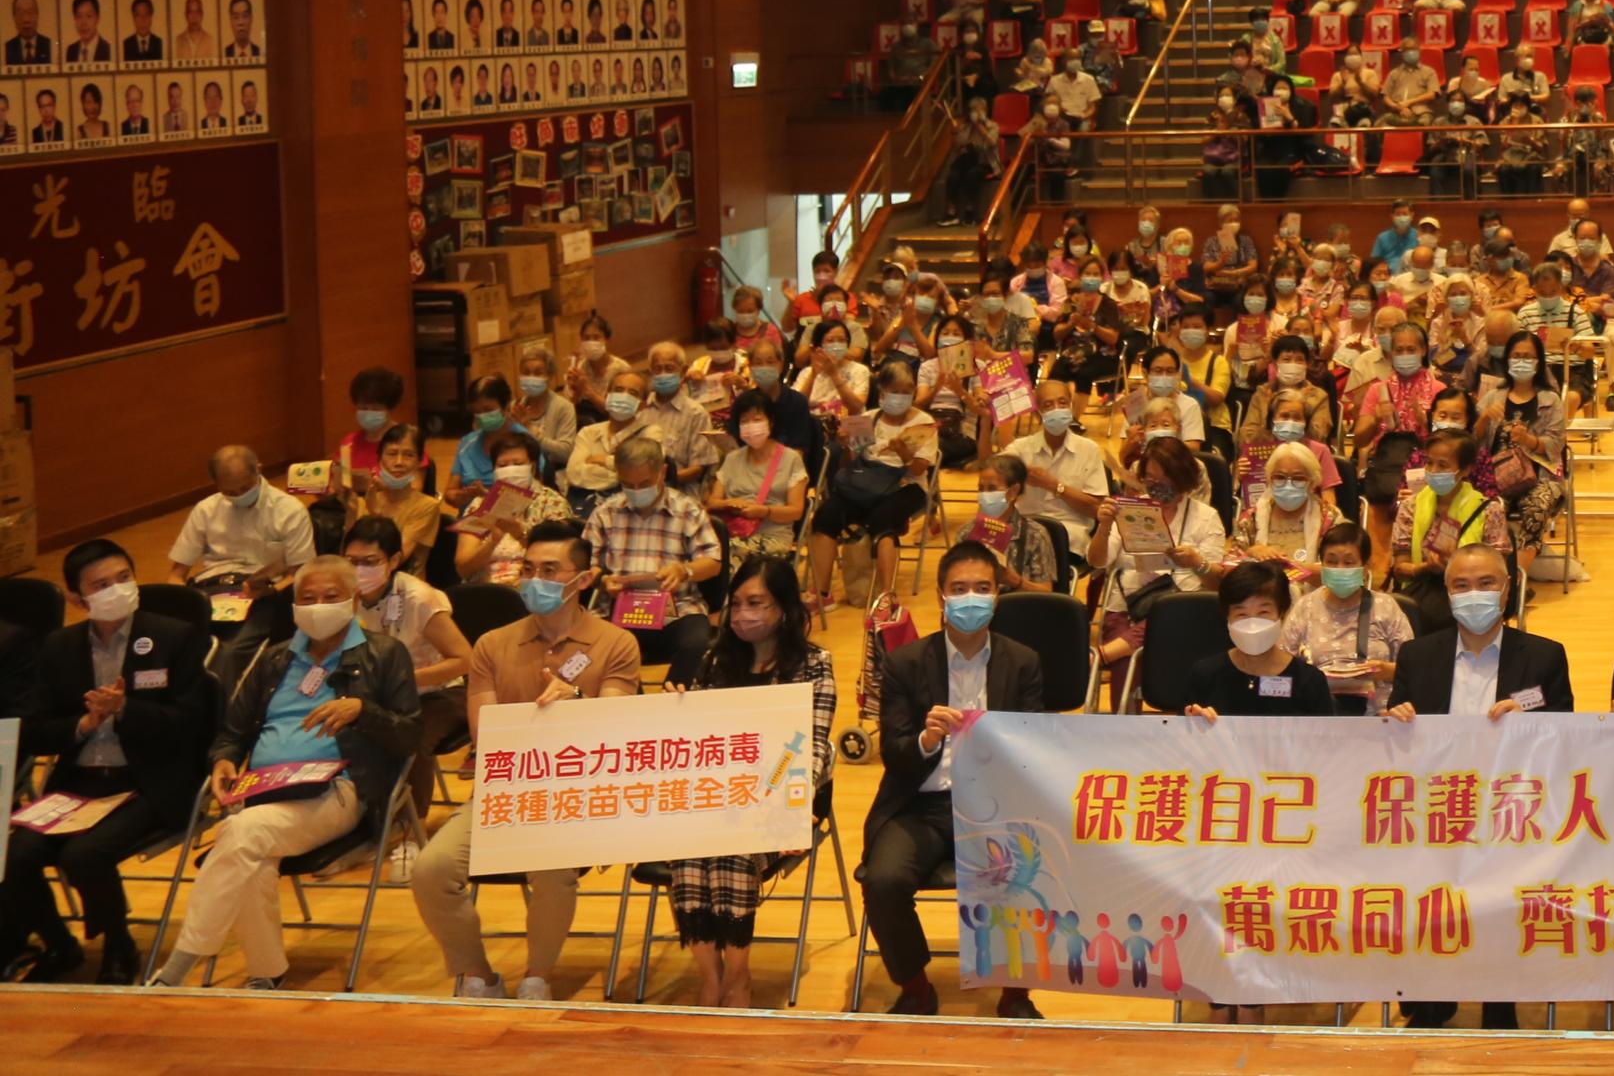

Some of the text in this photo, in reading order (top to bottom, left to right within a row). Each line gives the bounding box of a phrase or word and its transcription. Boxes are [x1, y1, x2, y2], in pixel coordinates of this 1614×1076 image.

[483, 732, 761, 784] 齊心合力預防病毒
[479, 773, 760, 826] 接種疫苗守護全家
[1072, 769, 1319, 848] 保護自己
[1360, 768, 1610, 847] 保護家人
[1217, 881, 1474, 960] 萬眾同心
